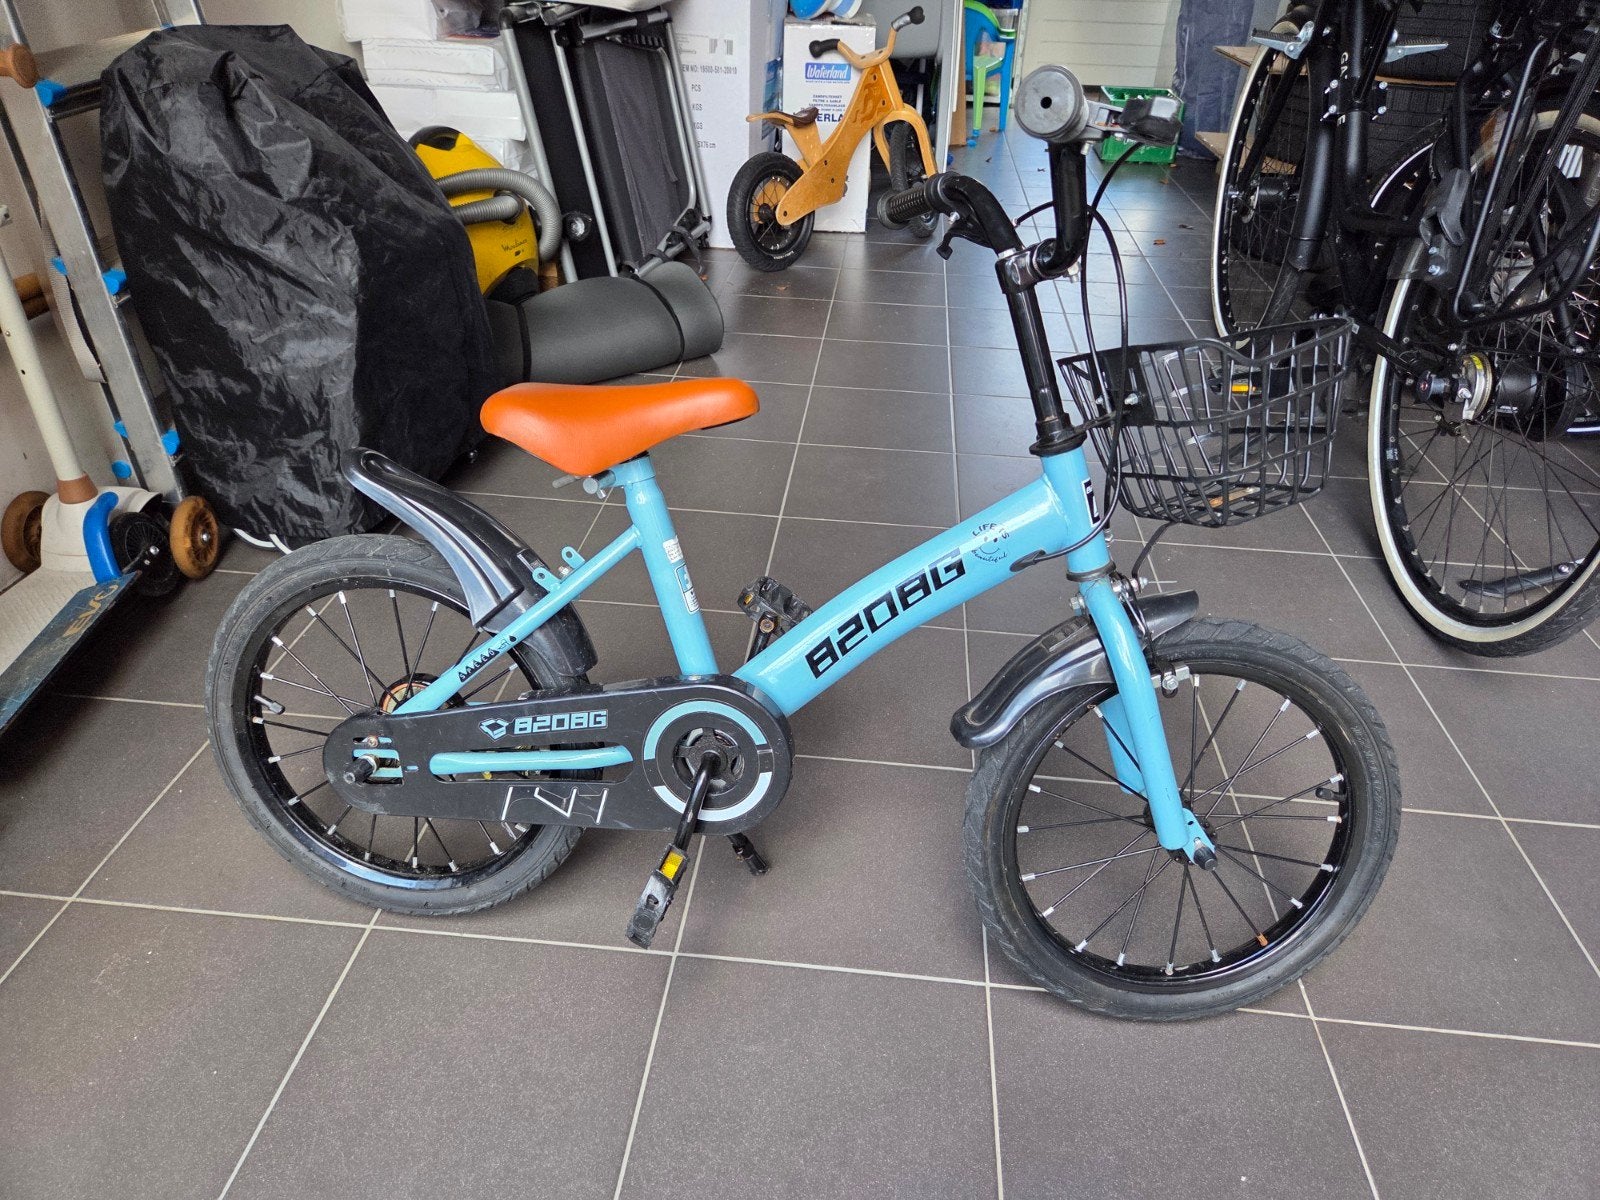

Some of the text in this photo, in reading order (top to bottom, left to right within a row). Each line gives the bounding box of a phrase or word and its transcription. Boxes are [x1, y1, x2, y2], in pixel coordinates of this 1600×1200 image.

[806, 64, 849, 79] Waterland
[817, 113, 843, 122] ERLA
[972, 522, 997, 536] LIFE
